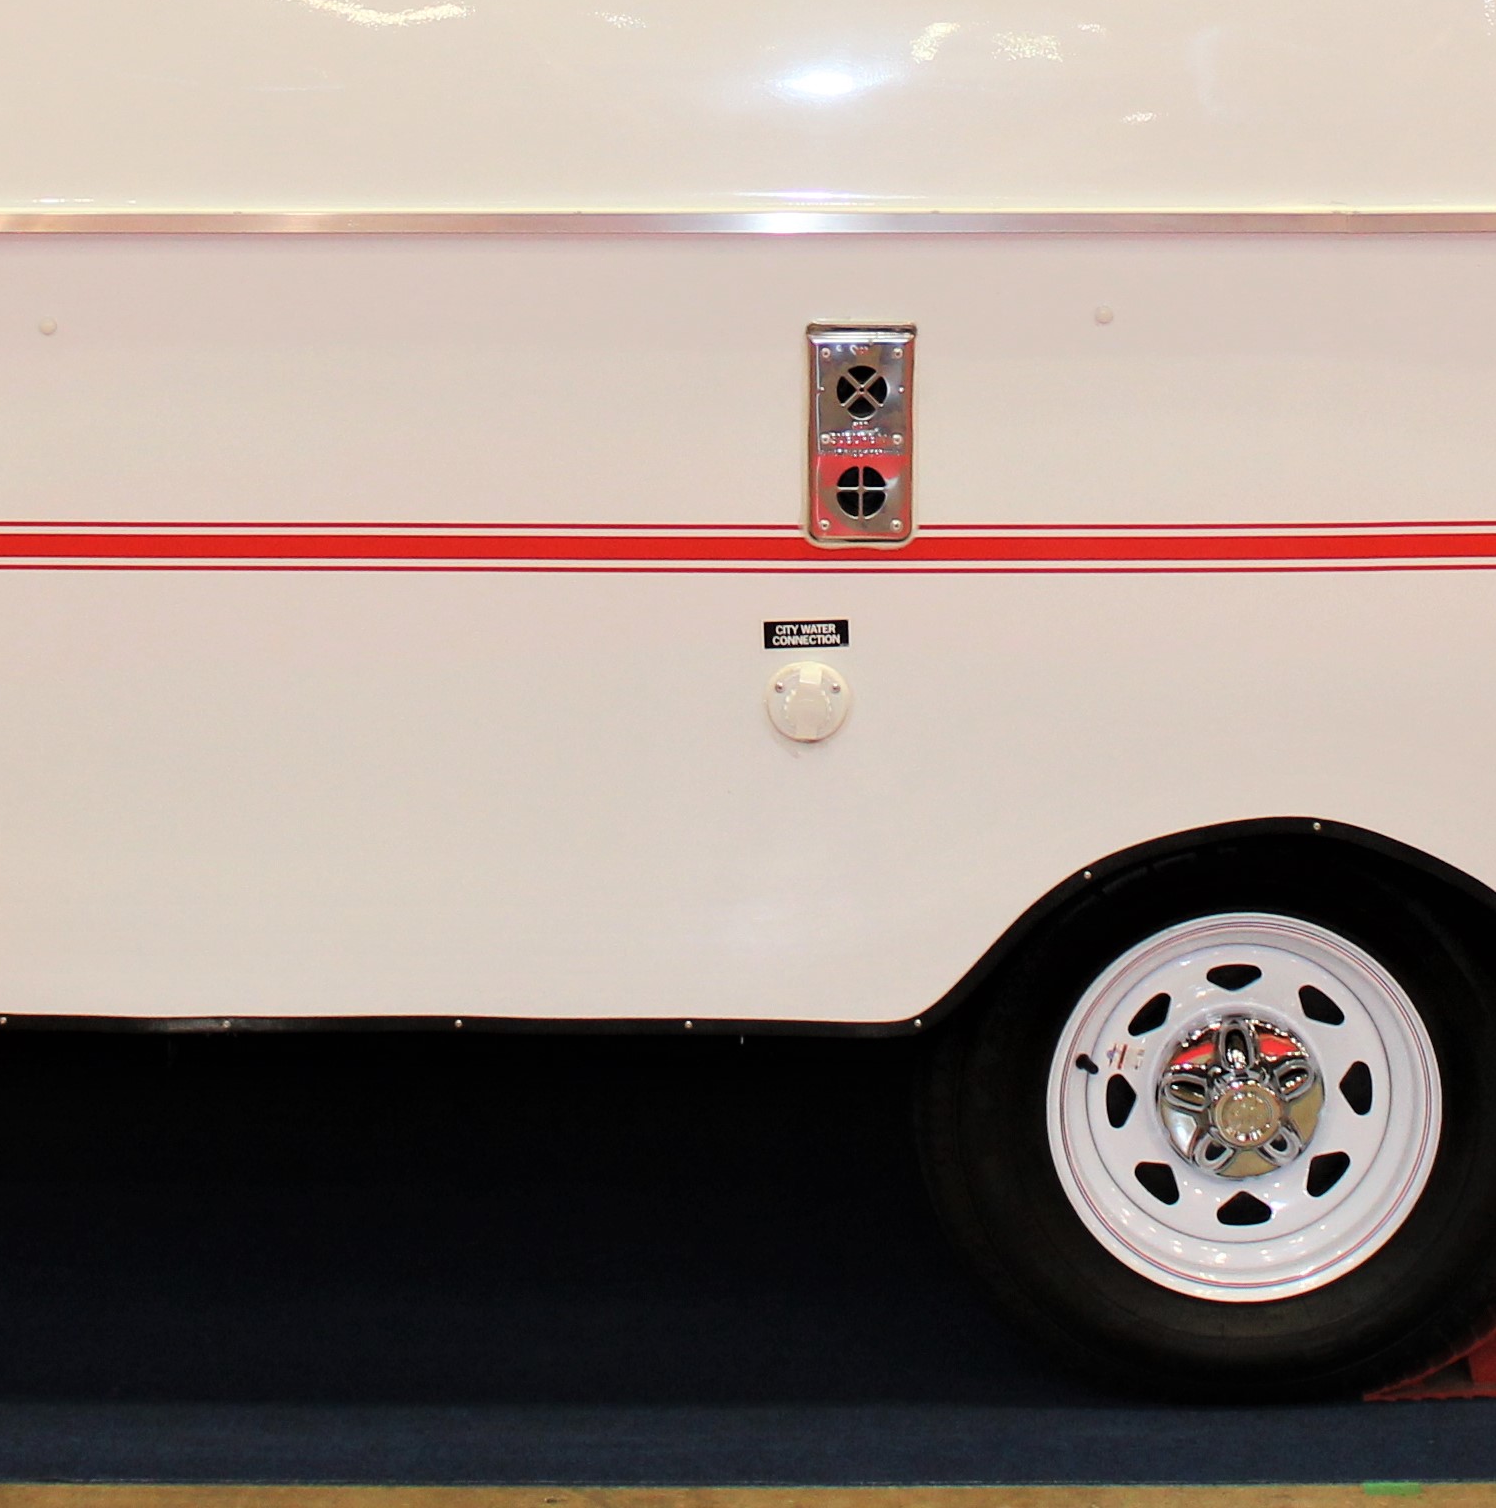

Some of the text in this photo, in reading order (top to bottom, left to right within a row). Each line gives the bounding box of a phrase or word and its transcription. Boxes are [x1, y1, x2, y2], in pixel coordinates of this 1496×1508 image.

[775, 623, 836, 636] CITY WATER
[772, 634, 841, 646] CONNECTION
